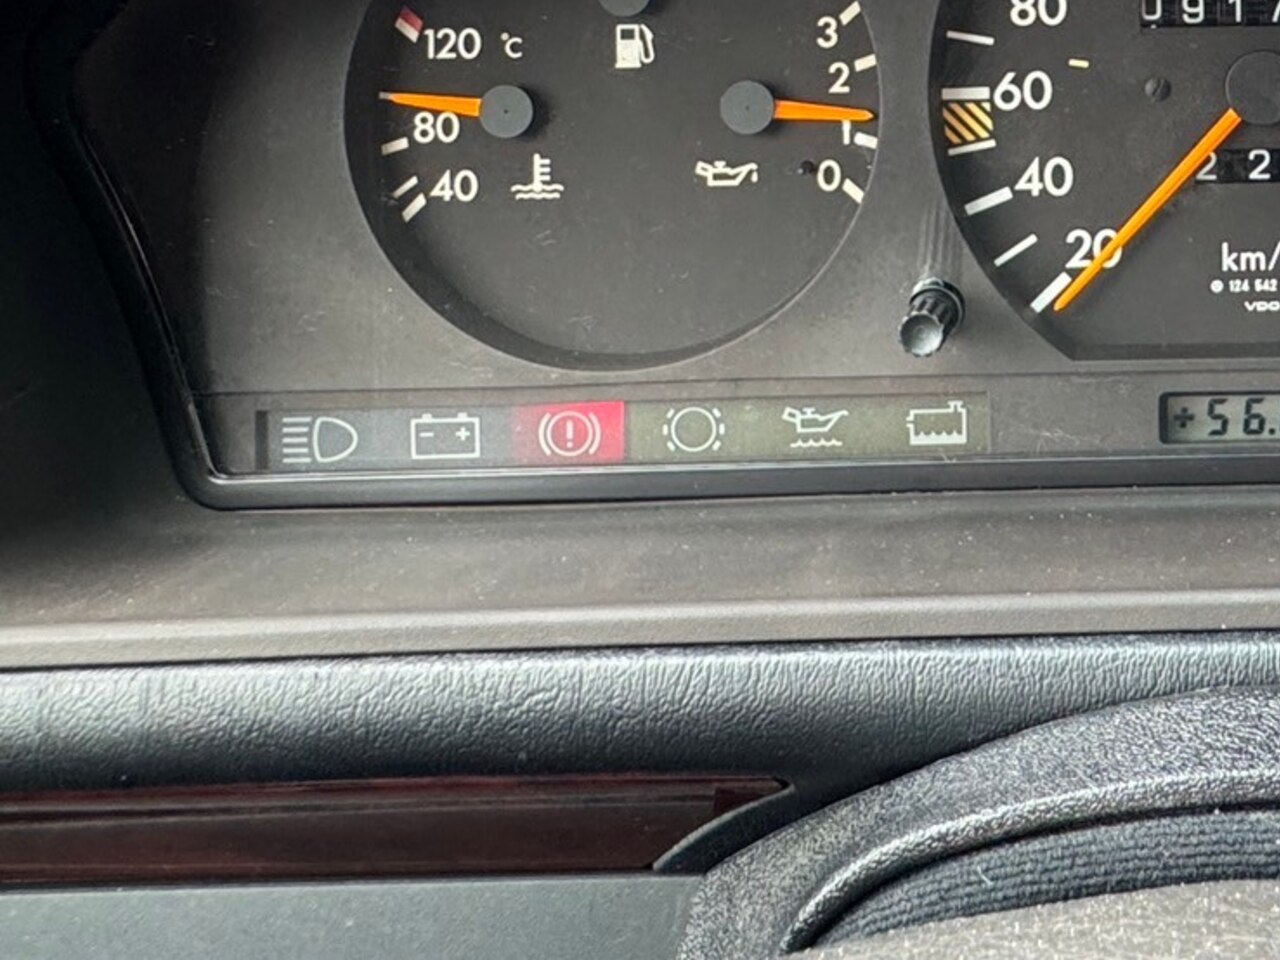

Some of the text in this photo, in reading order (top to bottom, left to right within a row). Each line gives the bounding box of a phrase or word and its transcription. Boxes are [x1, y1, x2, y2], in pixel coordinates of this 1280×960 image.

[424, 27, 481, 60] 120
[816, 16, 838, 49] 3
[828, 61, 850, 93] 2
[993, 70, 1053, 111] 60
[413, 112, 460, 144] 80
[429, 169, 478, 202] 40
[817, 159, 841, 192] 0
[1013, 155, 1074, 198] 40
[1065, 228, 1122, 269] 20
